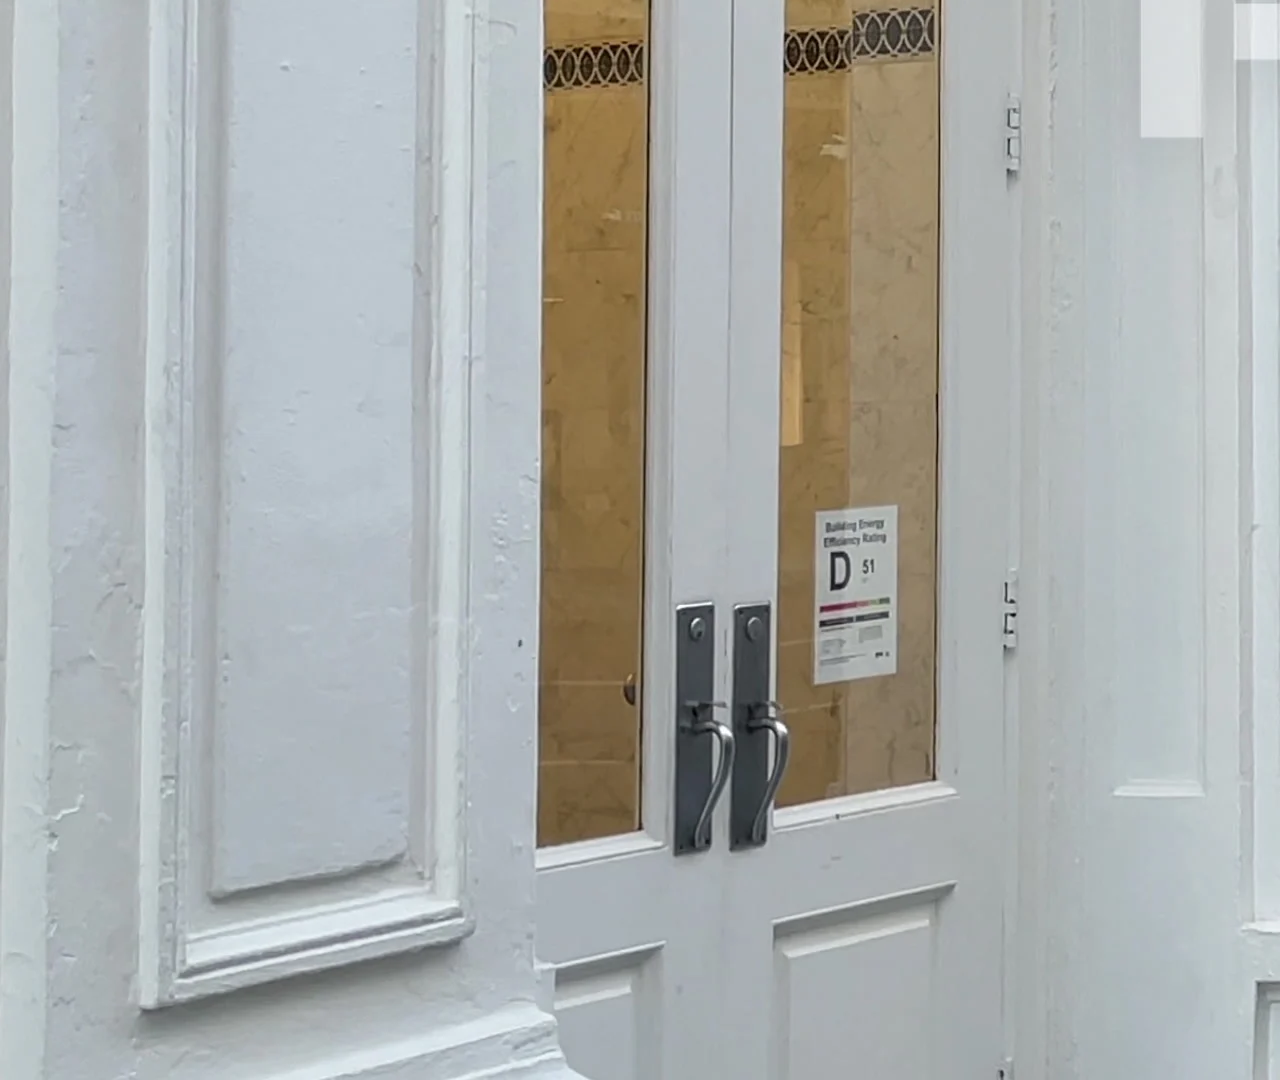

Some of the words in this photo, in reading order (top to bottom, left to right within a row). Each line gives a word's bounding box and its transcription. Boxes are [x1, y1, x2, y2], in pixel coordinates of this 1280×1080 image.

[825, 522, 857, 533] Building
[859, 519, 885, 530] Energy
[823, 537, 861, 548] Efficiency
[862, 533, 886, 544] Rating
[830, 551, 851, 591] D
[862, 559, 875, 574] 51
